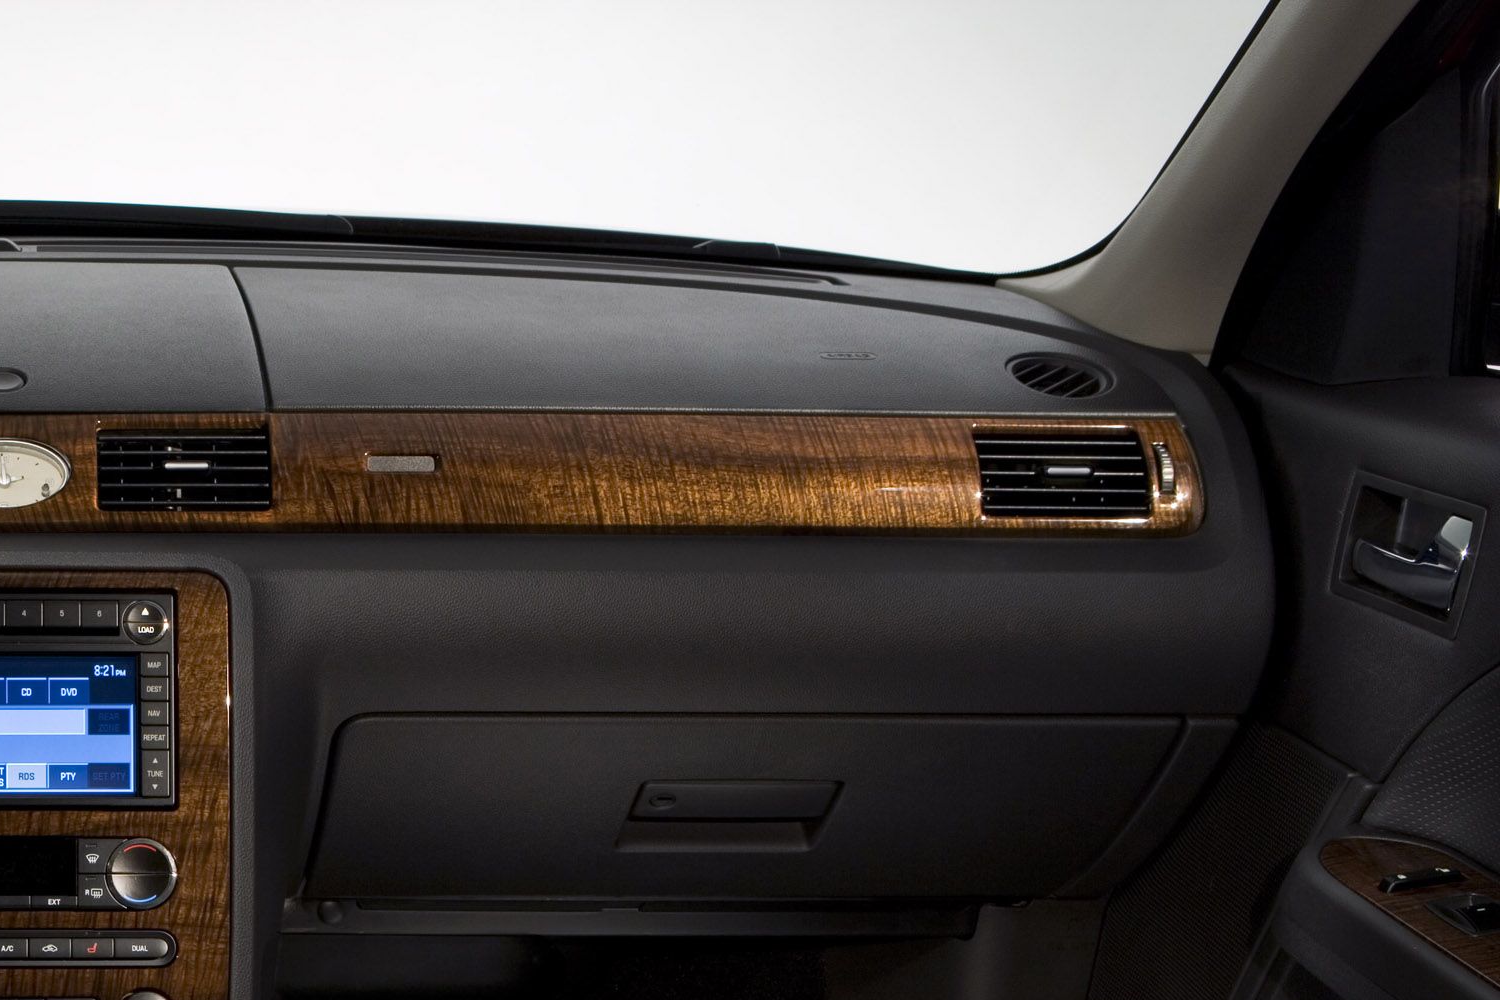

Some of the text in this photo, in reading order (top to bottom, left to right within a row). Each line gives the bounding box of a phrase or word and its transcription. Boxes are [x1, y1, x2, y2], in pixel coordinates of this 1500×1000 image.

[138, 626, 154, 634] LOAD
[21, 688, 32, 696] CD
[60, 688, 78, 696] DVD
[98, 712, 120, 720] REAR
[18, 772, 35, 780] RDS
[60, 772, 76, 780] PTY
[148, 770, 163, 778] TUNE
[48, 898, 61, 906] EXT
